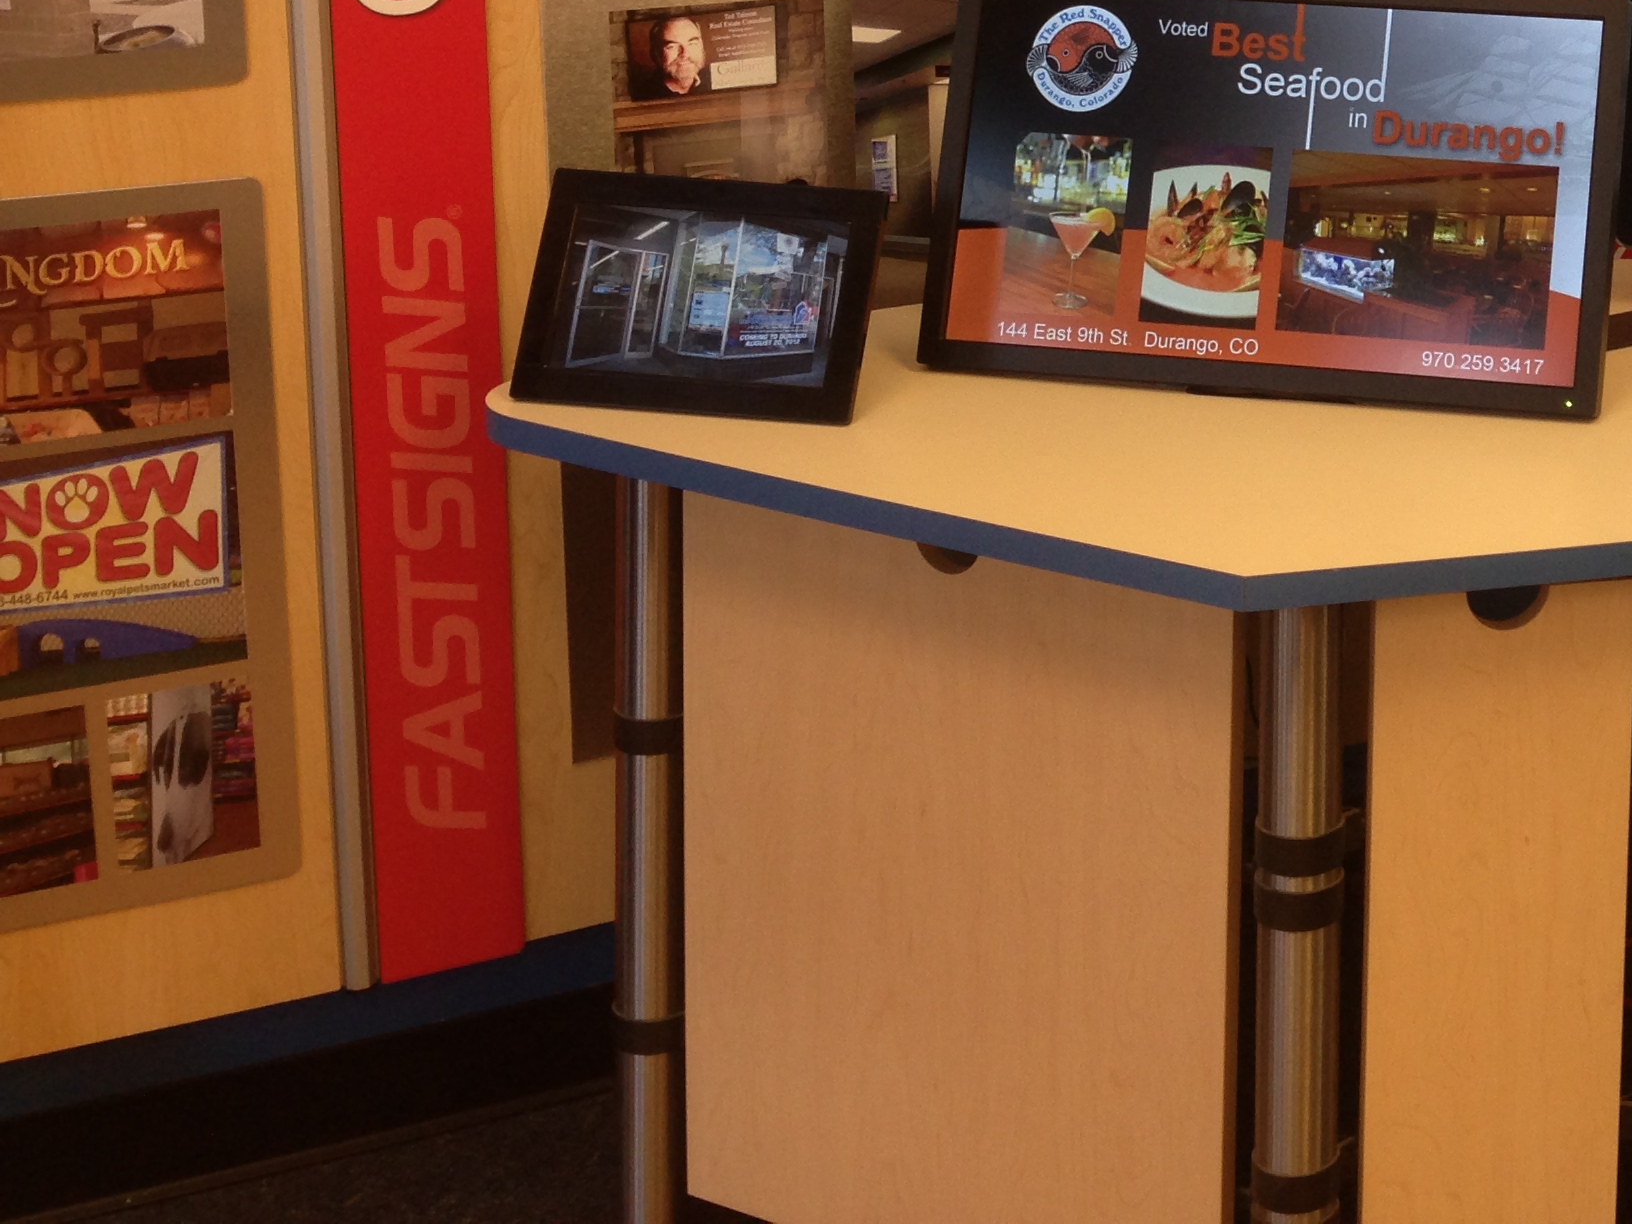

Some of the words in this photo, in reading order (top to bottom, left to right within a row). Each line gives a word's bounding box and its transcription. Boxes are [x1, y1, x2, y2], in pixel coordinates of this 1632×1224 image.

[1038, 22, 1060, 43] The
[1059, 8, 1085, 24] Red
[1089, 8, 1128, 47] Snapper
[1158, 17, 1209, 40] Voted
[1211, 4, 1307, 63] Best
[1079, 76, 1124, 108] Colorado
[1348, 107, 1368, 129] in
[1371, 109, 1565, 162] Durango!
[0, 238, 190, 297] NGDOM
[997, 320, 1028, 339] 144
[1033, 323, 1073, 343] East
[1077, 325, 1105, 346] 9th
[1144, 329, 1224, 356] Durango,
[1229, 337, 1260, 357] CO
[1421, 349, 1545, 376] 970.259.3417
[0, 451, 199, 541] NOW
[376, 216, 487, 830] FASTSIGNS
[0, 509, 218, 596] OPEN
